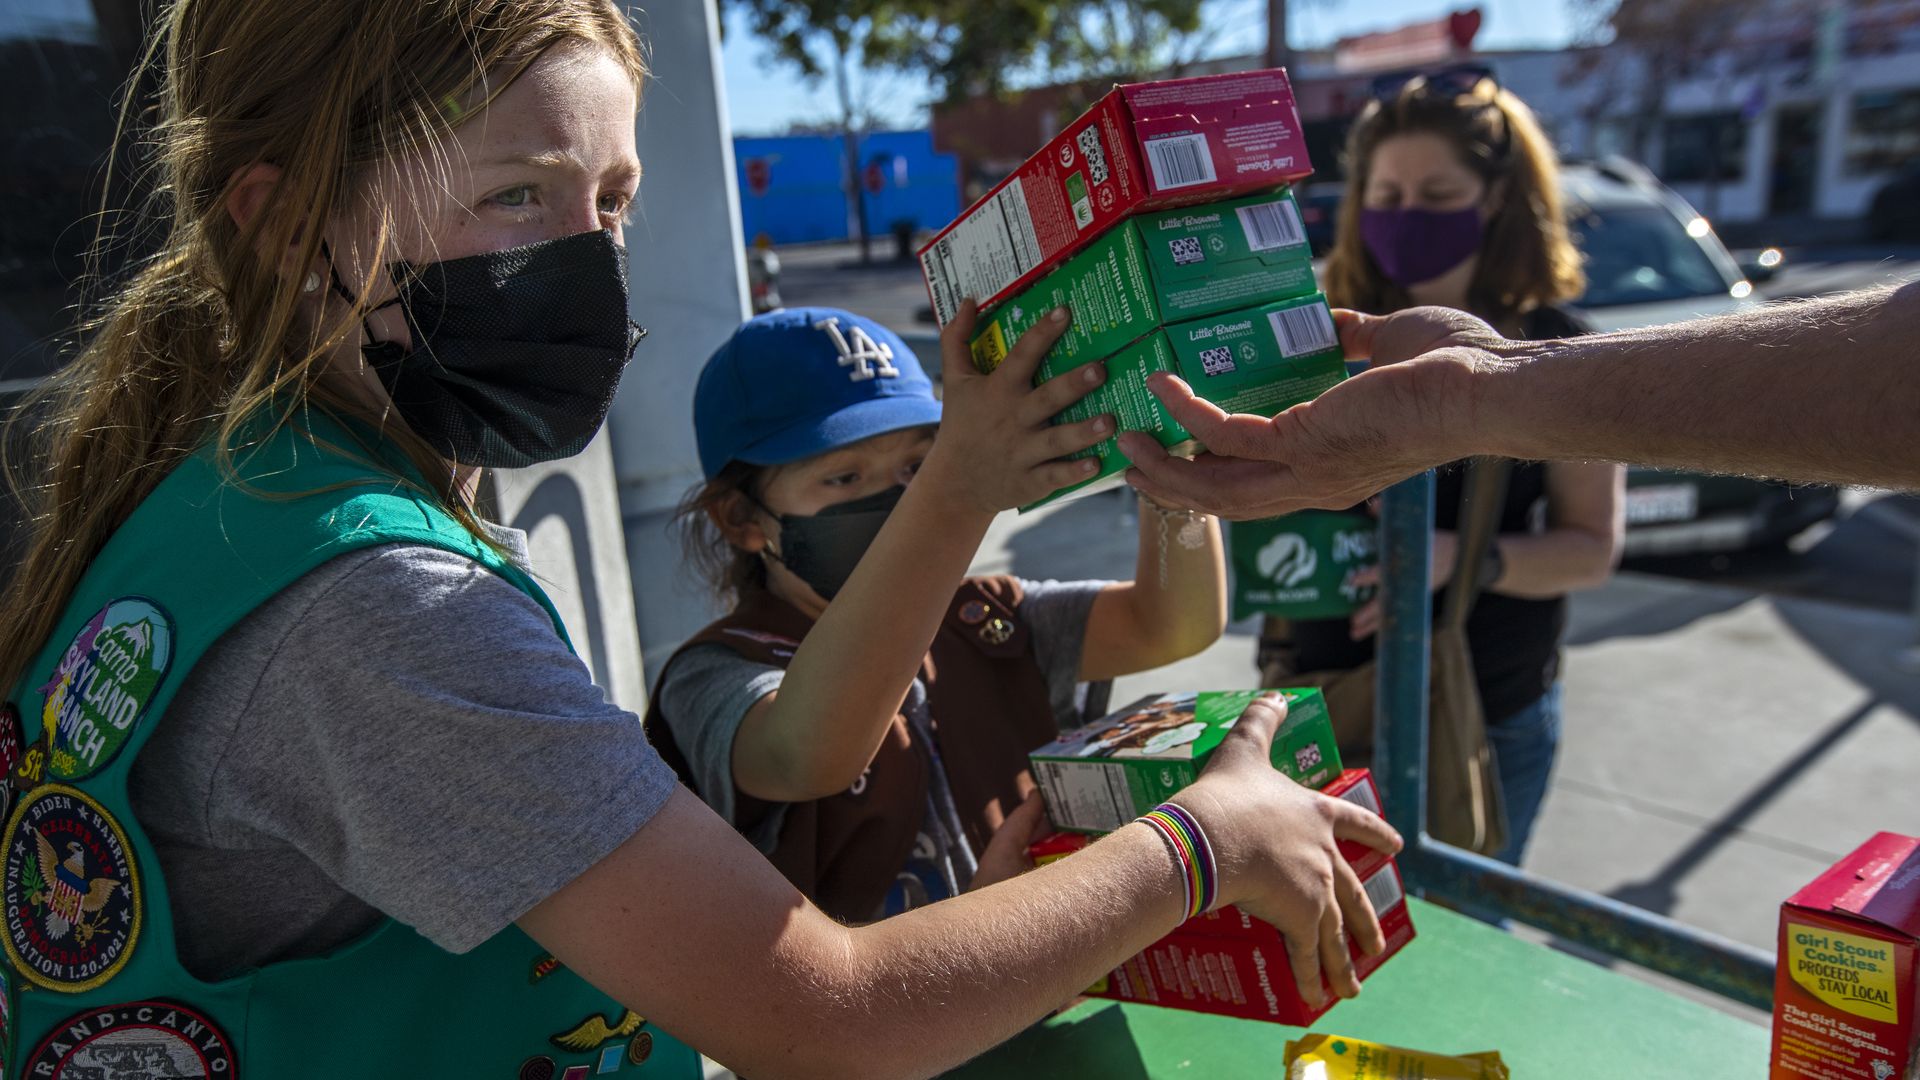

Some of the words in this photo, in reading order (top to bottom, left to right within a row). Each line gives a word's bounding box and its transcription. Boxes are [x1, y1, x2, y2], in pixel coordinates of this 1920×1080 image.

[1159, 217, 1182, 230] Little
[1181, 213, 1221, 227] Brownie
[924, 252, 936, 282] Facts
[1120, 293, 1132, 323] thin
[814, 317, 900, 382] LA
[1190, 328, 1213, 341] Little
[1212, 320, 1252, 335] Brownie
[1151, 402, 1163, 432] thin
[92, 625, 139, 685] Camp
[60, 645, 138, 730] SKYLAND
[50, 684, 106, 767] RANCH
[32, 796, 72, 820] BIDEN
[92, 815, 129, 878] HARRIS
[40, 818, 113, 876] CELEBRATE
[7, 857, 63, 977] INAUGURATION
[69, 930, 126, 979] 1.20.2021
[19, 906, 97, 964] DEMOCRACY
[1795, 933, 1828, 951] Girl
[1833, 939, 1886, 961] Scout
[1798, 960, 1859, 984] PROCEEDS
[1818, 978, 1847, 995] STAY
[1852, 985, 1891, 1004] LOCAL
[137, 1007, 228, 1073] CANYO
[1782, 1013, 1828, 1037] Cookie
[1783, 1004, 1809, 1019] The
[1810, 1012, 1836, 1029] Girl
[1838, 1023, 1877, 1042] Scout
